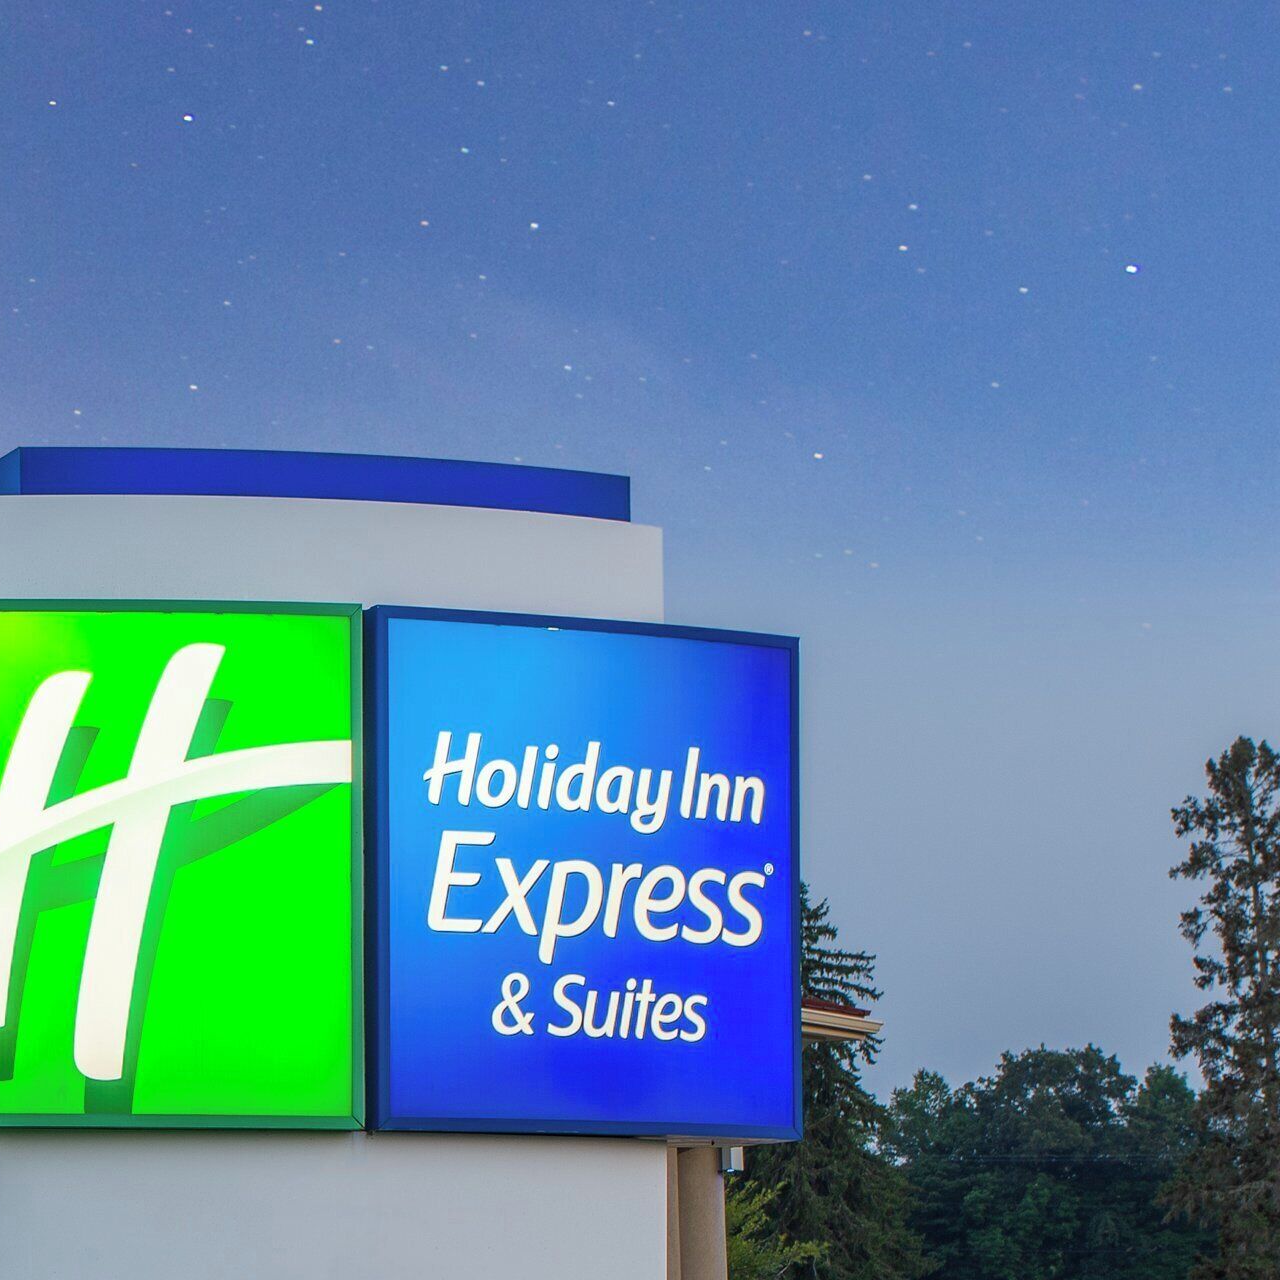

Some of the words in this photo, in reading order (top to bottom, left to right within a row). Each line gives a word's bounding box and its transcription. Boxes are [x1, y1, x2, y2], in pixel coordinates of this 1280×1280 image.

[423, 731, 673, 834] Holiday
[680, 747, 765, 825] Inn
[491, 972, 535, 1036] &
[547, 973, 708, 1042] Suites
